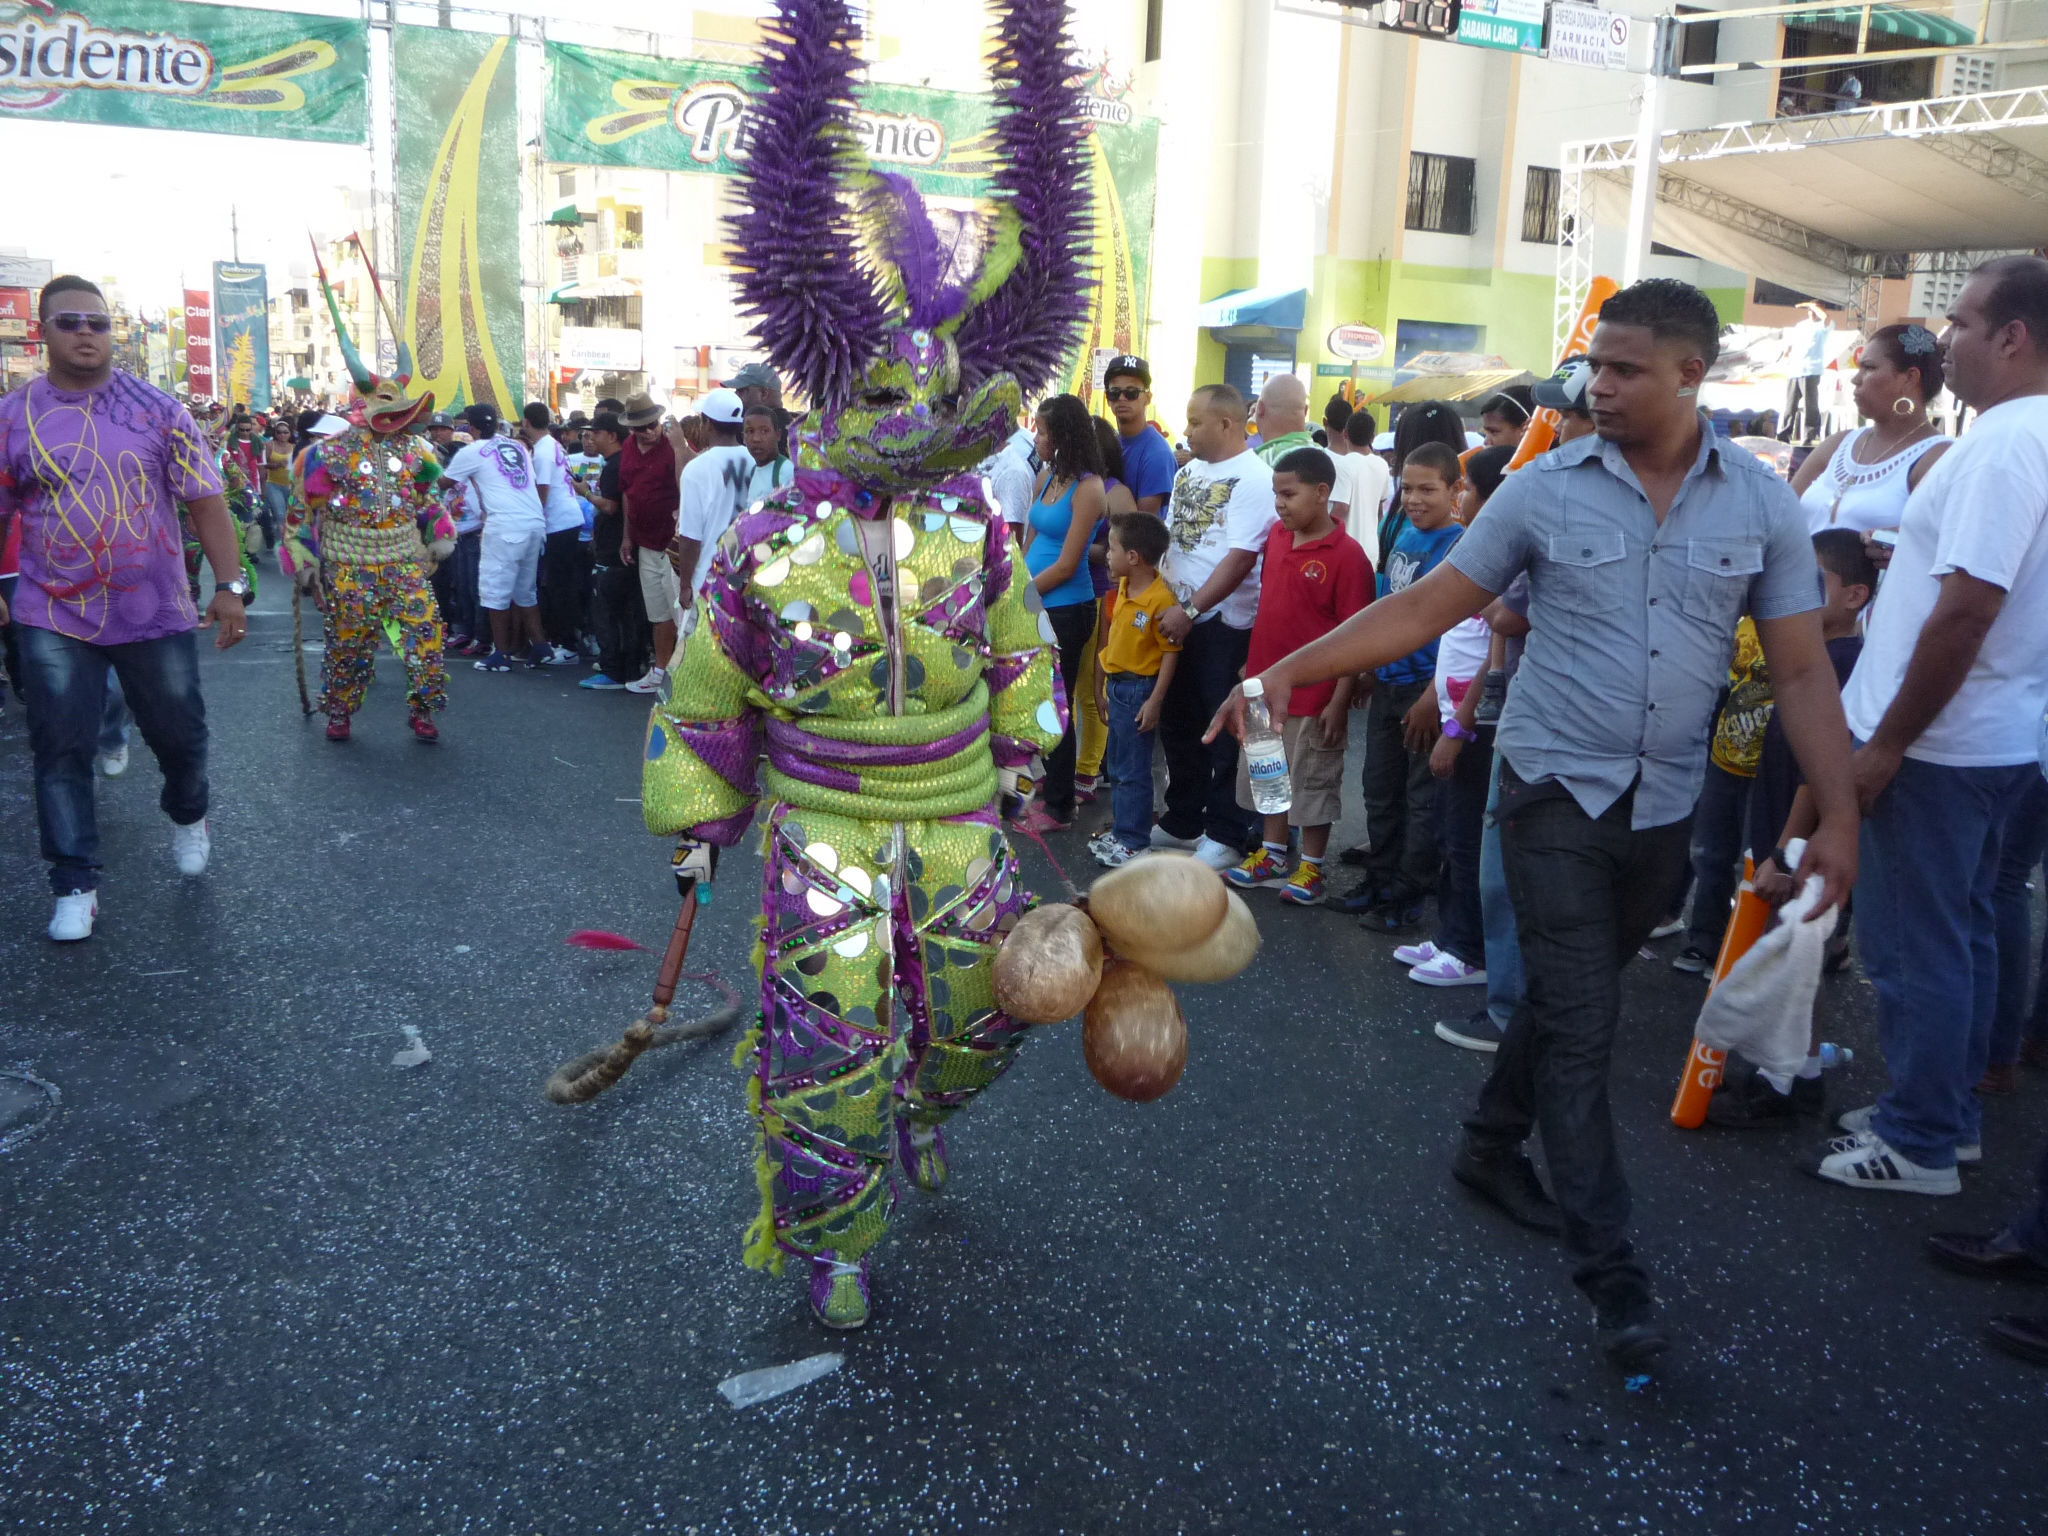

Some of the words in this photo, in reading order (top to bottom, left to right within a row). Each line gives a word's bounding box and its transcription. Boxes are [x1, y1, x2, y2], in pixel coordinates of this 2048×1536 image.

[1460, 18, 1491, 41] SABANA
[1492, 23, 1518, 46] LARGA
[1556, 30, 1605, 48] FARMACIA
[1552, 44, 1579, 62] SANTA
[1581, 48, 1605, 65] LUCIA
[571, 349, 611, 360] Caribbean
[1123, 355, 1137, 368] NY
[190, 364, 213, 376] Cla
